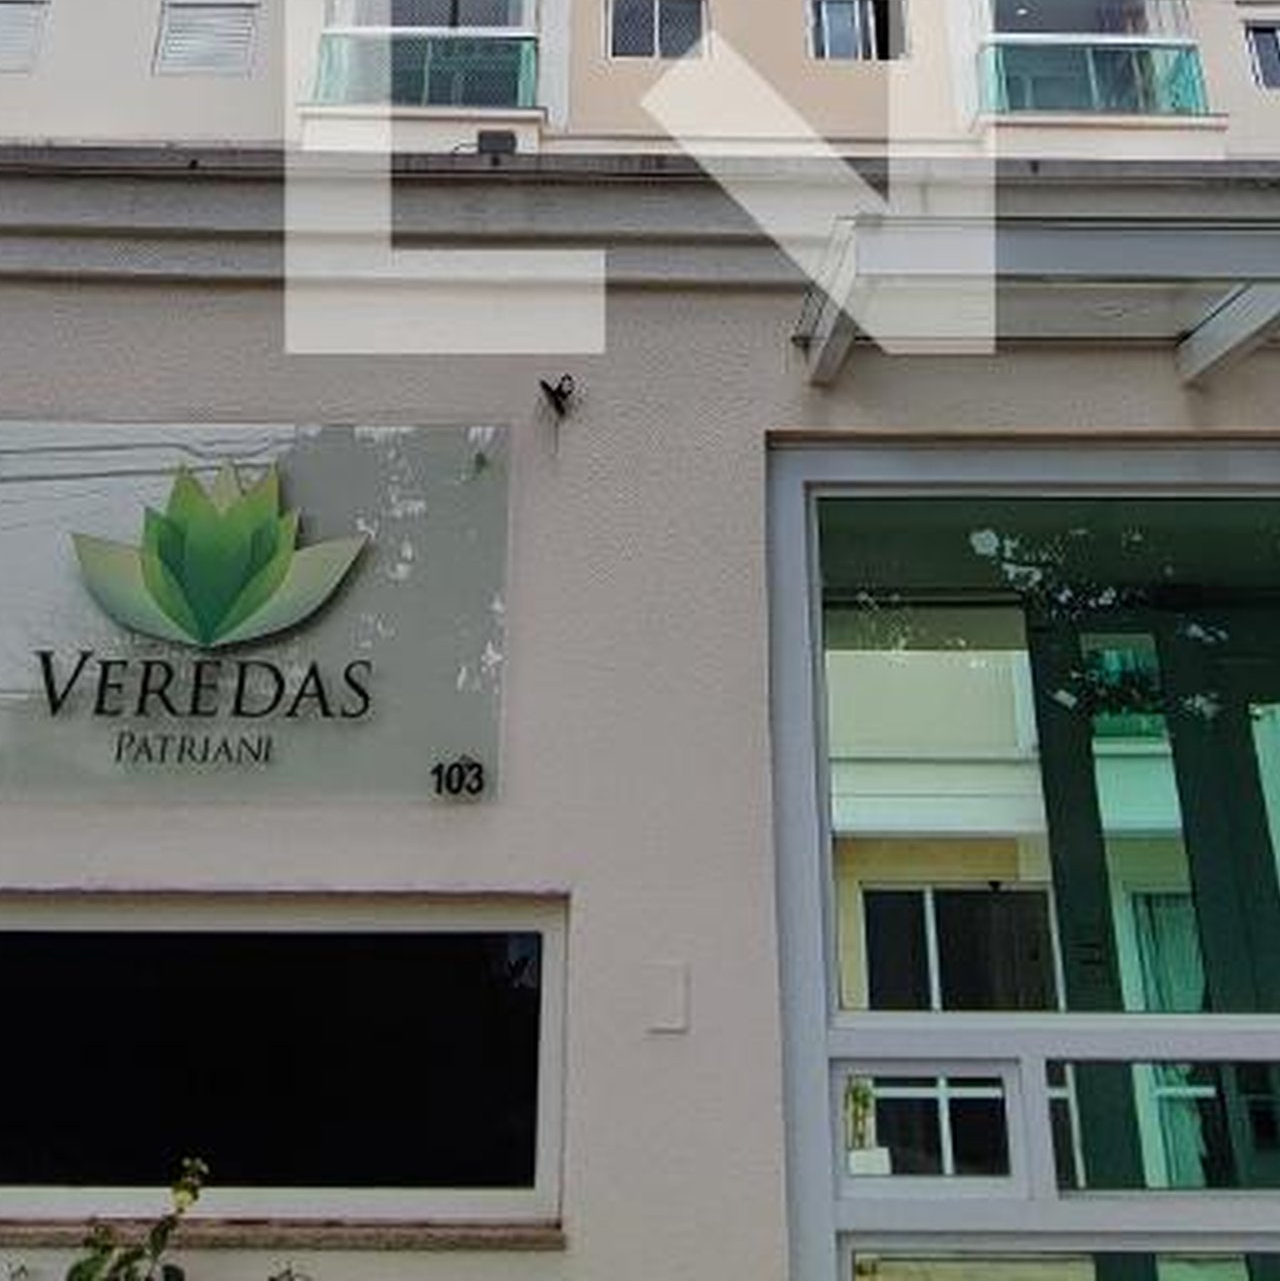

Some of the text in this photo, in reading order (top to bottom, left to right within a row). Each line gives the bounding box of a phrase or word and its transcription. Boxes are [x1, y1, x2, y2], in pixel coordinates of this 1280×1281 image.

[35, 649, 373, 719] VEREDAS
[115, 731, 273, 765] PATRIANI
[431, 761, 485, 796] 103
